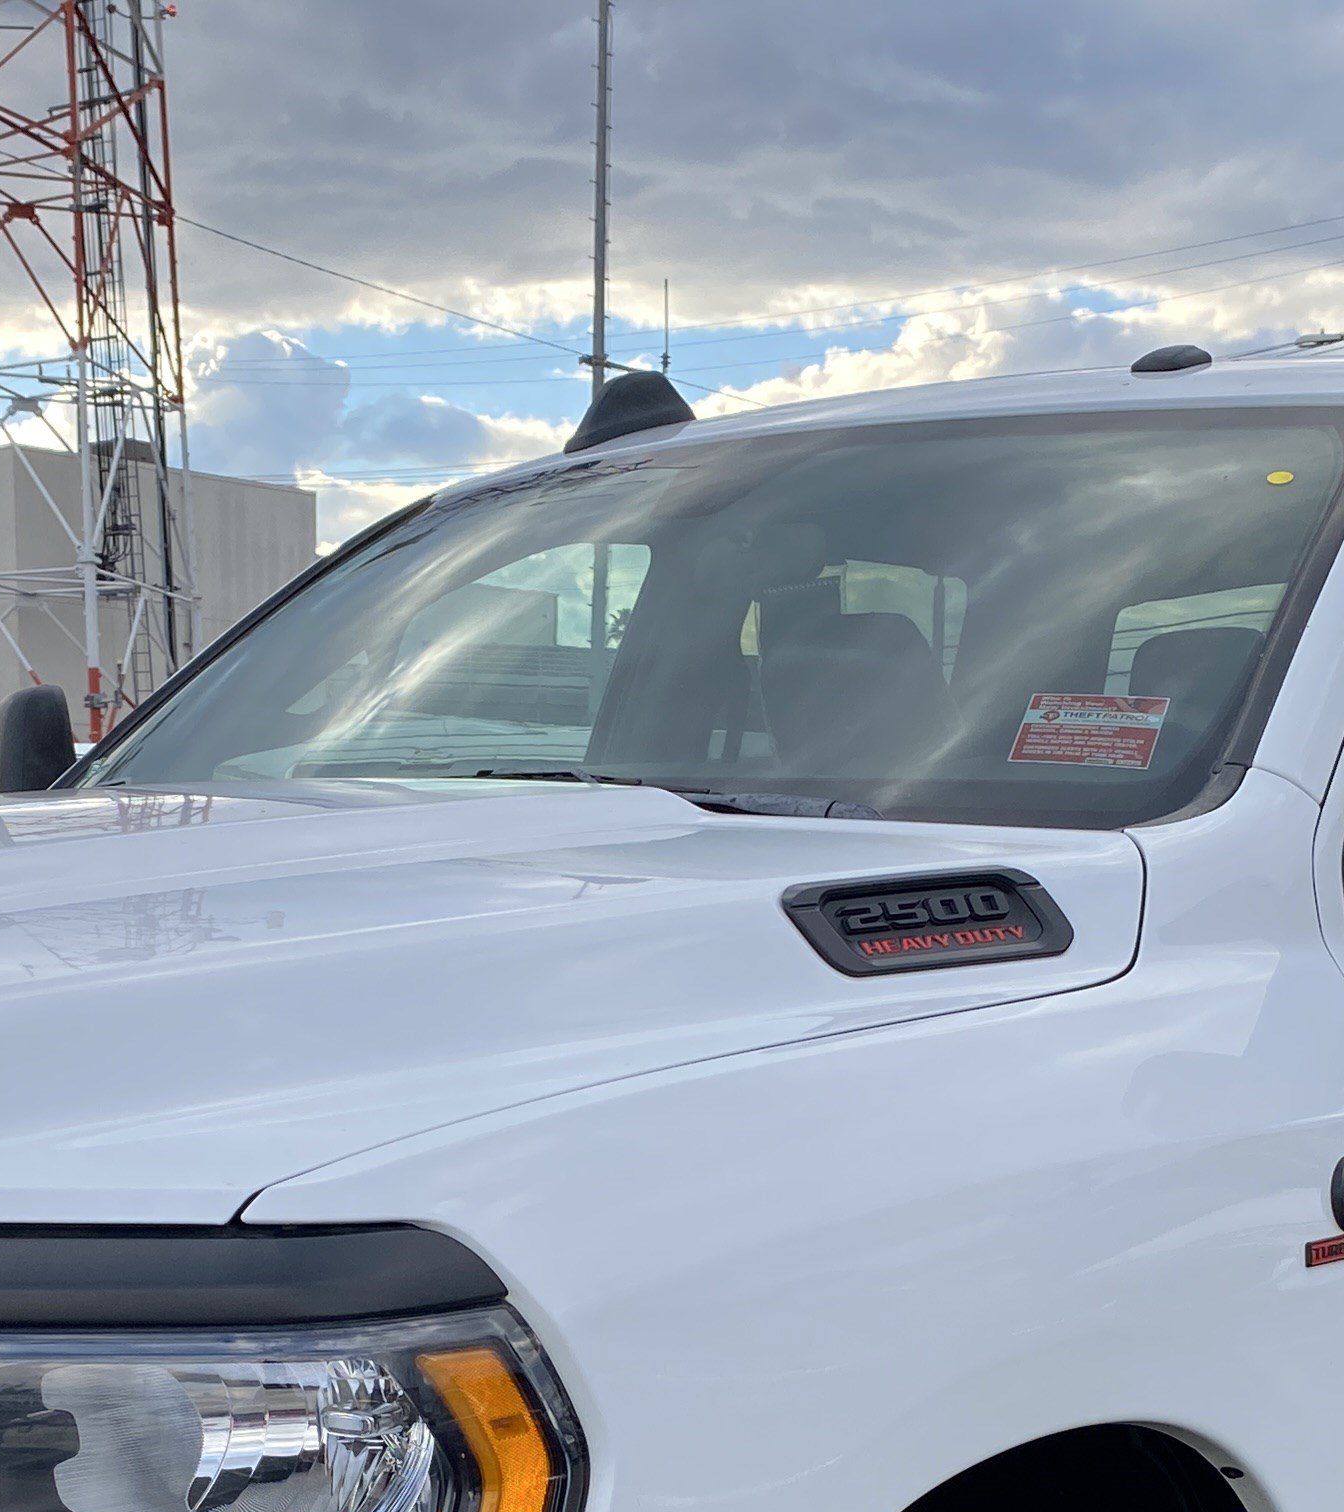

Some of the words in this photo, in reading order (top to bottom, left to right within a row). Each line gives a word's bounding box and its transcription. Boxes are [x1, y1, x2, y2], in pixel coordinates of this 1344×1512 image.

[836, 889, 1011, 935] 2500
[860, 932, 950, 956] HEAVY
[952, 925, 1025, 946] DUTY
